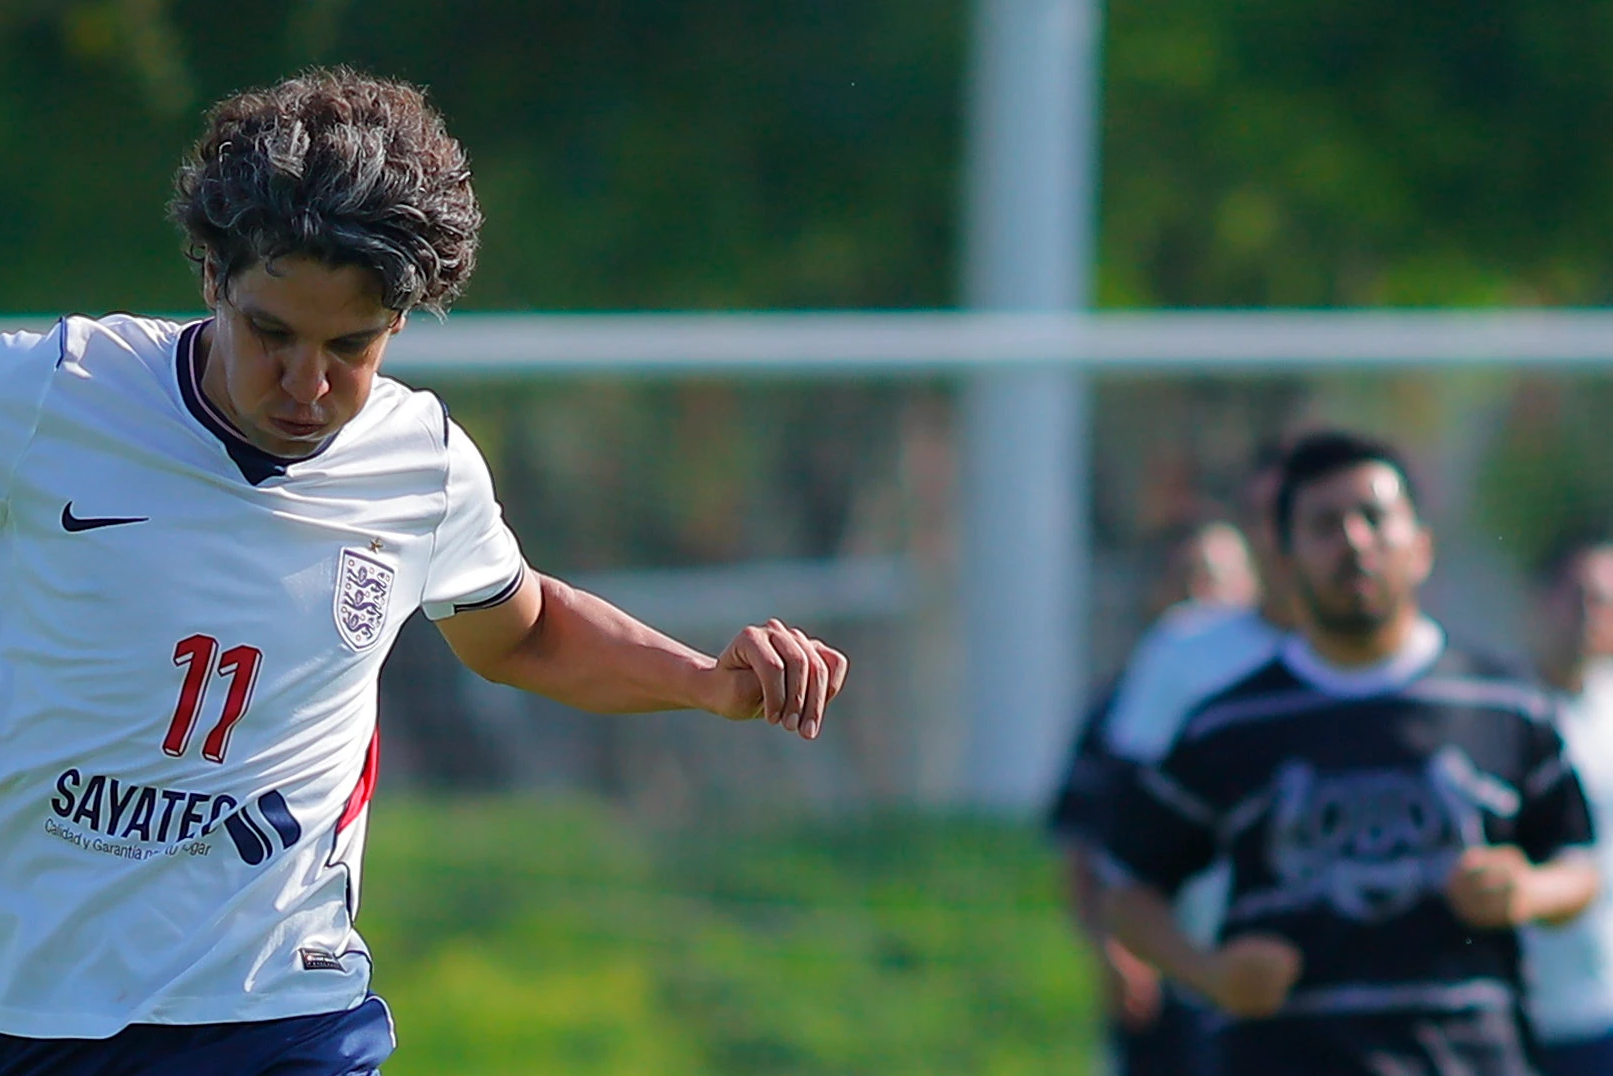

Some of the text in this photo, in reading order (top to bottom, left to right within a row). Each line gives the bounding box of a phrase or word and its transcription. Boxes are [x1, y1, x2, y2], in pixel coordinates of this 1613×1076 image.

[161, 632, 263, 764] 11
[45, 817, 82, 846] Calidad
[83, 837, 91, 850] y
